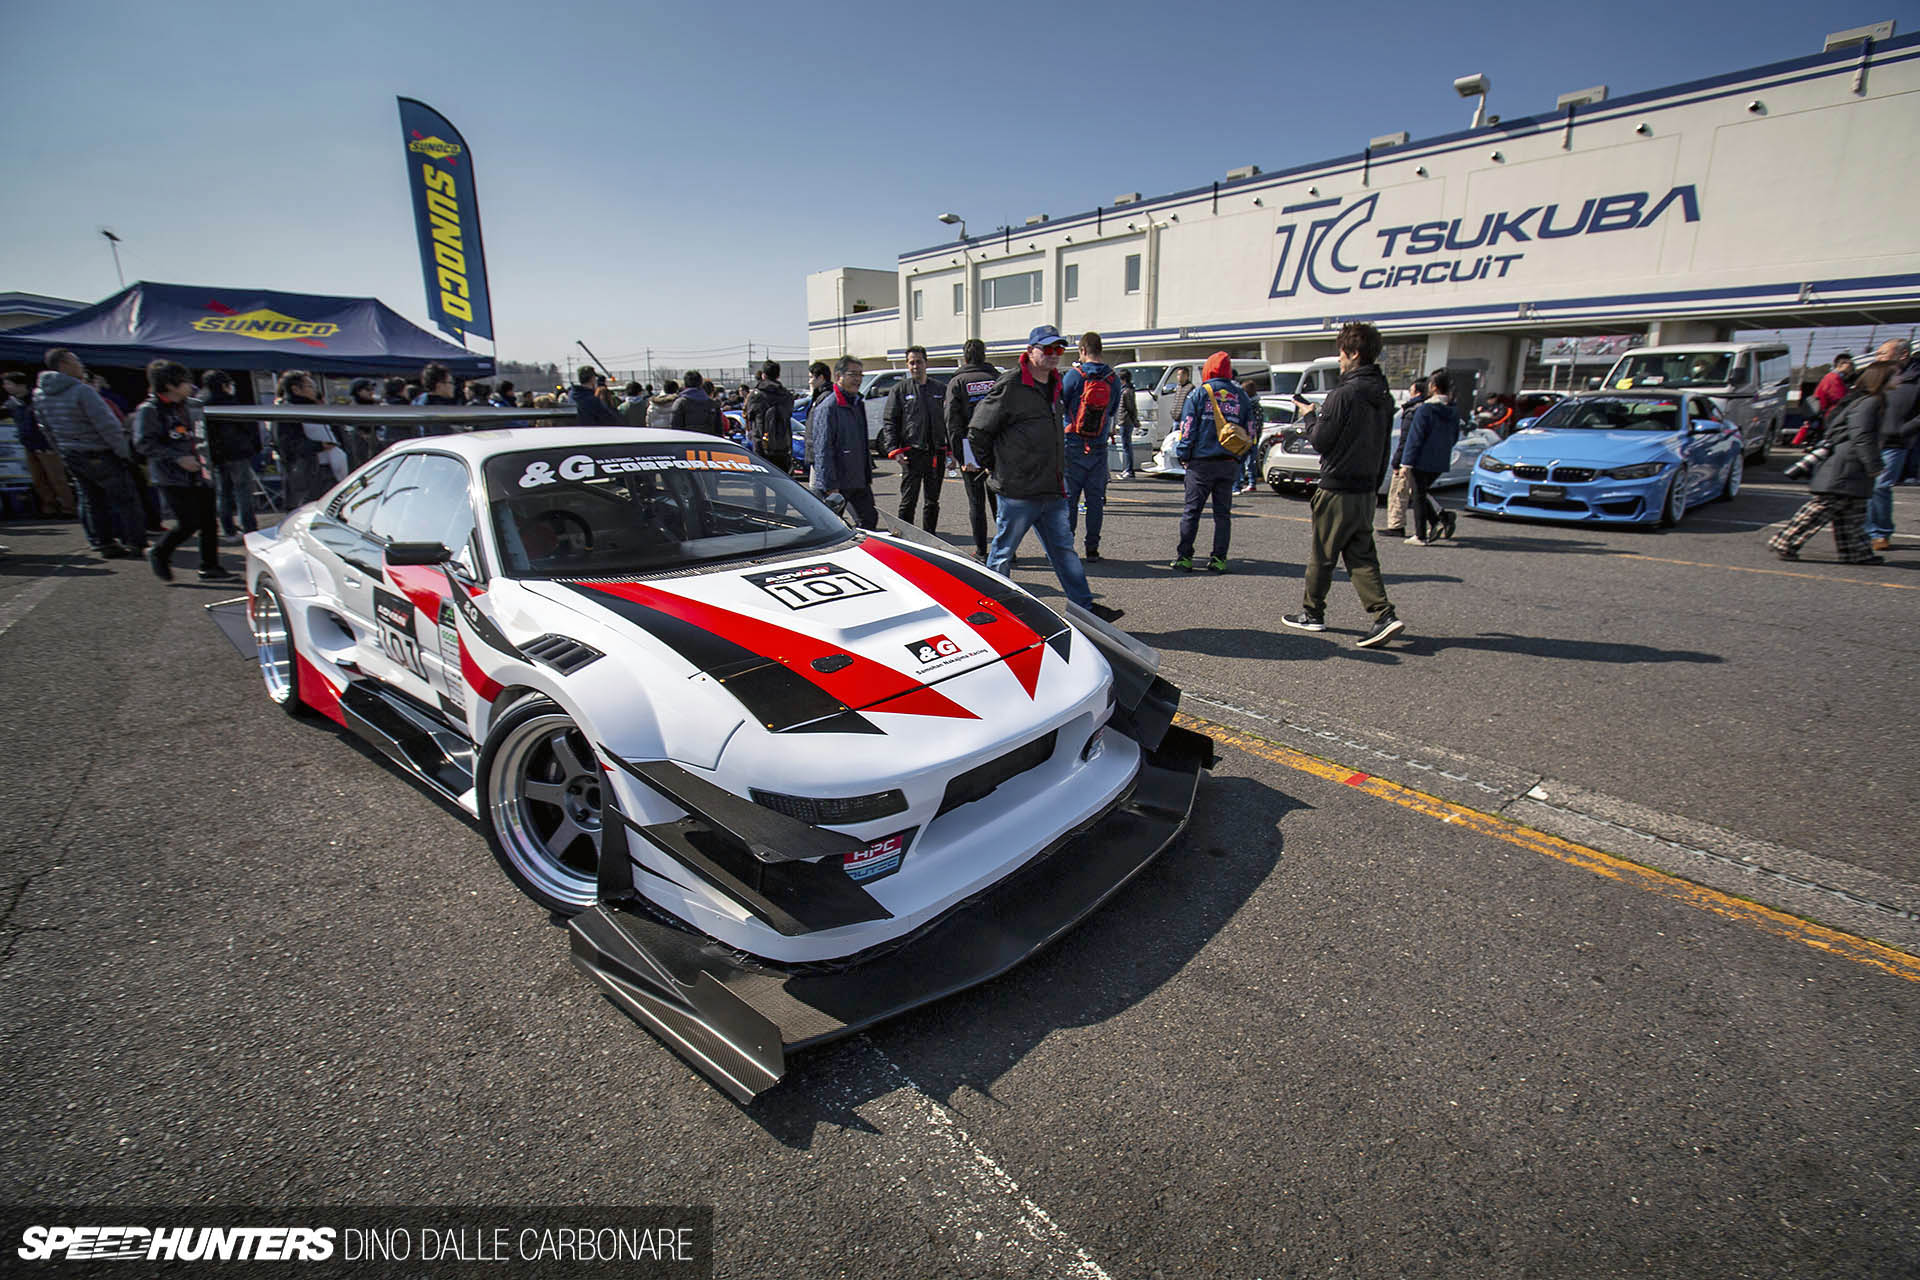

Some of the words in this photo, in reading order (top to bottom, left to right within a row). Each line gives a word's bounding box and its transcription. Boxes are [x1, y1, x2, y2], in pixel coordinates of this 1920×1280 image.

[411, 141, 460, 154] SUNOCO
[1376, 184, 1701, 258] TSUKUBA
[422, 163, 474, 323] SUNOCO
[196, 319, 332, 335] SUNOCO
[518, 455, 595, 488] &G
[765, 566, 830, 583] ADVAN
[774, 576, 869, 602] 101
[919, 640, 958, 662] &G
[968, 648, 989, 657] Racing
[853, 839, 895, 860] HPC
